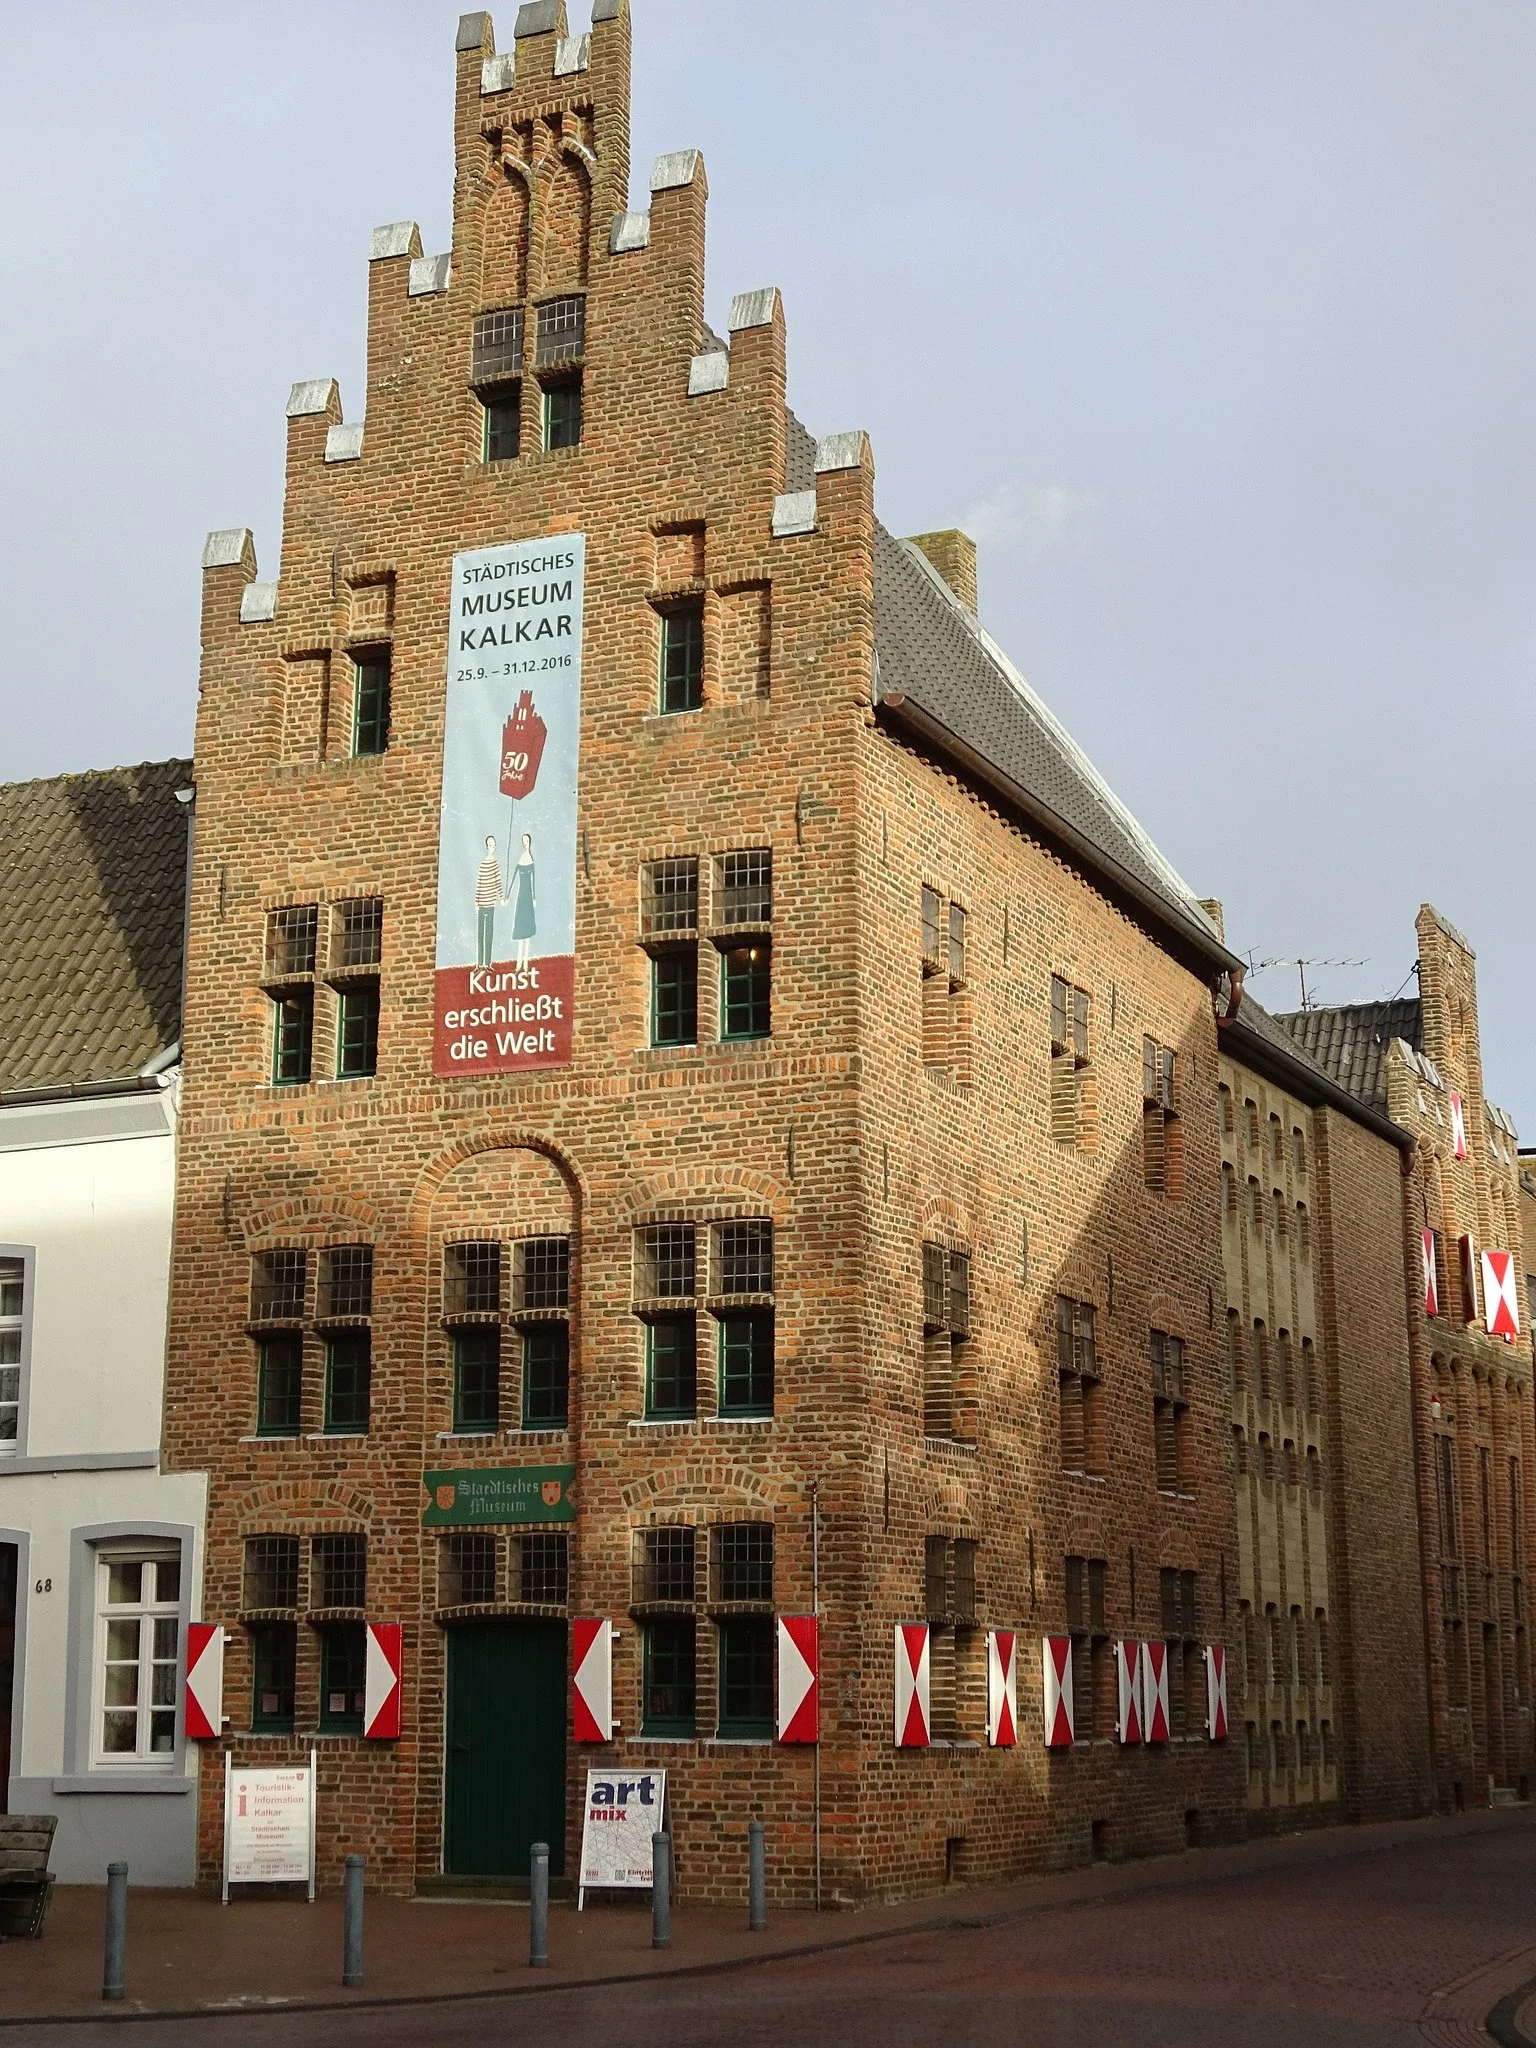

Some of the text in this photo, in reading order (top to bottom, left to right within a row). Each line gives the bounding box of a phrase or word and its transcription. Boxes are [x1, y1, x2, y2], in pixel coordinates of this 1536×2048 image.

[462, 552, 574, 585] STÄDTISCHES
[461, 580, 572, 617] MUSEUM
[460, 614, 572, 651] KALKAR
[457, 667, 488, 682] 25.9.
[503, 655, 571, 675] 31.12.2016
[502, 751, 529, 772] 50
[469, 967, 540, 995] Kunst
[444, 994, 564, 1029] erschließt
[450, 1027, 556, 1060] die Welt
[457, 1478, 539, 1496] Staedtisches
[468, 1497, 527, 1516] Museum
[35, 1578, 52, 1594] 68
[254, 1795, 304, 1805] Information
[255, 1784, 296, 1792] Touristik-
[591, 1775, 655, 1806] art
[254, 1809, 282, 1817] Kalkar
[589, 1805, 628, 1822] mix
